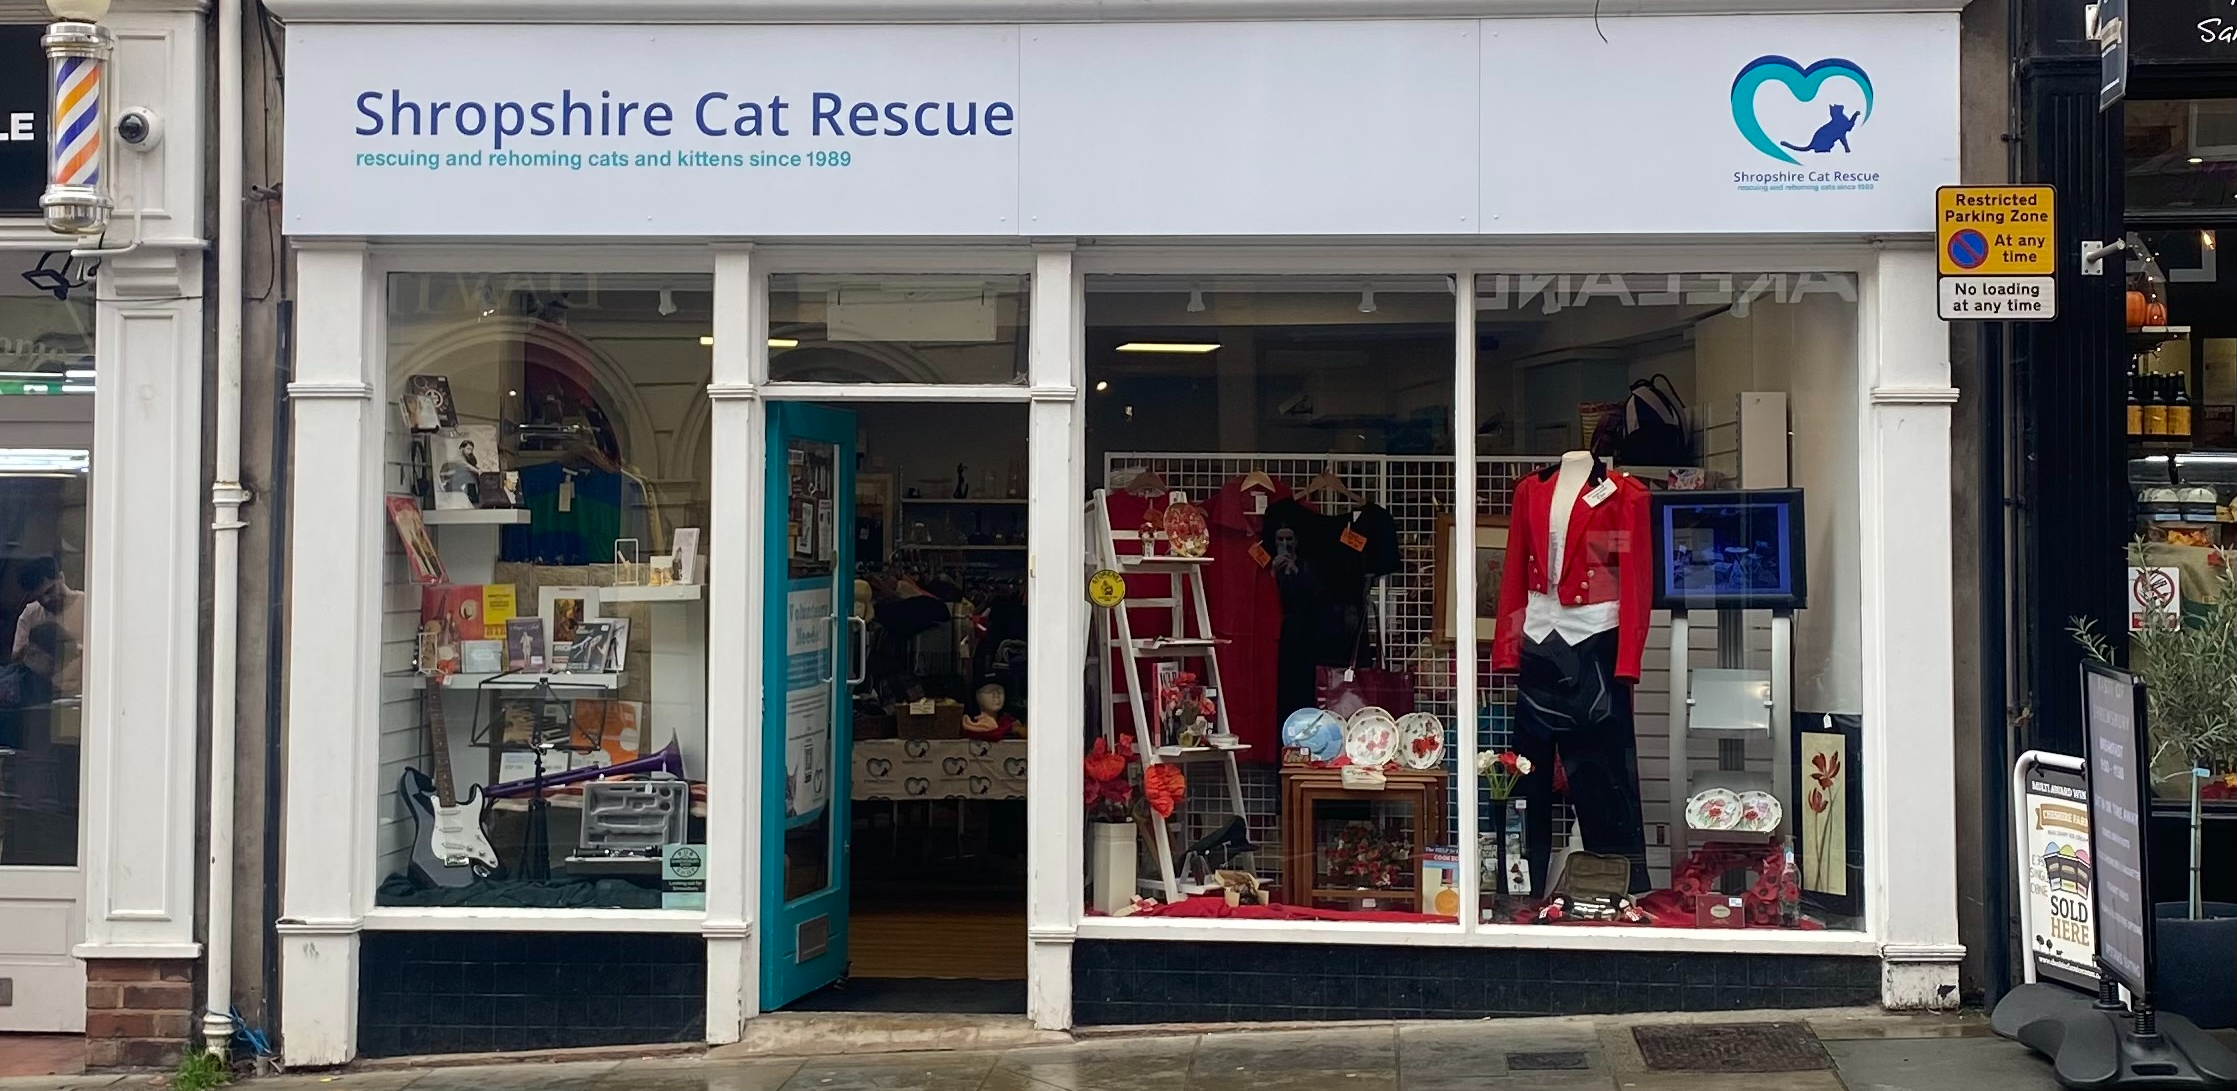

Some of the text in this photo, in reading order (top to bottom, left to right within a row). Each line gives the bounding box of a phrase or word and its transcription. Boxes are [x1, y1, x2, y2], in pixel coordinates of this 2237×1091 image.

[2197, 17, 2237, 43] Sa
[356, 89, 1014, 150] Shropshire Cat Rescue
[356, 150, 851, 170] rescuing and rehoming cats and kittens since 1989
[1734, 171, 1880, 184] Shropshire Cat Rescue
[1956, 193, 2037, 206] Restricted
[1945, 210, 2049, 224] Parking Zone
[1994, 234, 2046, 248] At any
[2003, 250, 2037, 262] time
[1955, 283, 2040, 297] No loading
[1953, 300, 2041, 313] at any time
[2051, 895, 2088, 923] SOLD
[2051, 917, 2090, 946] HERE
